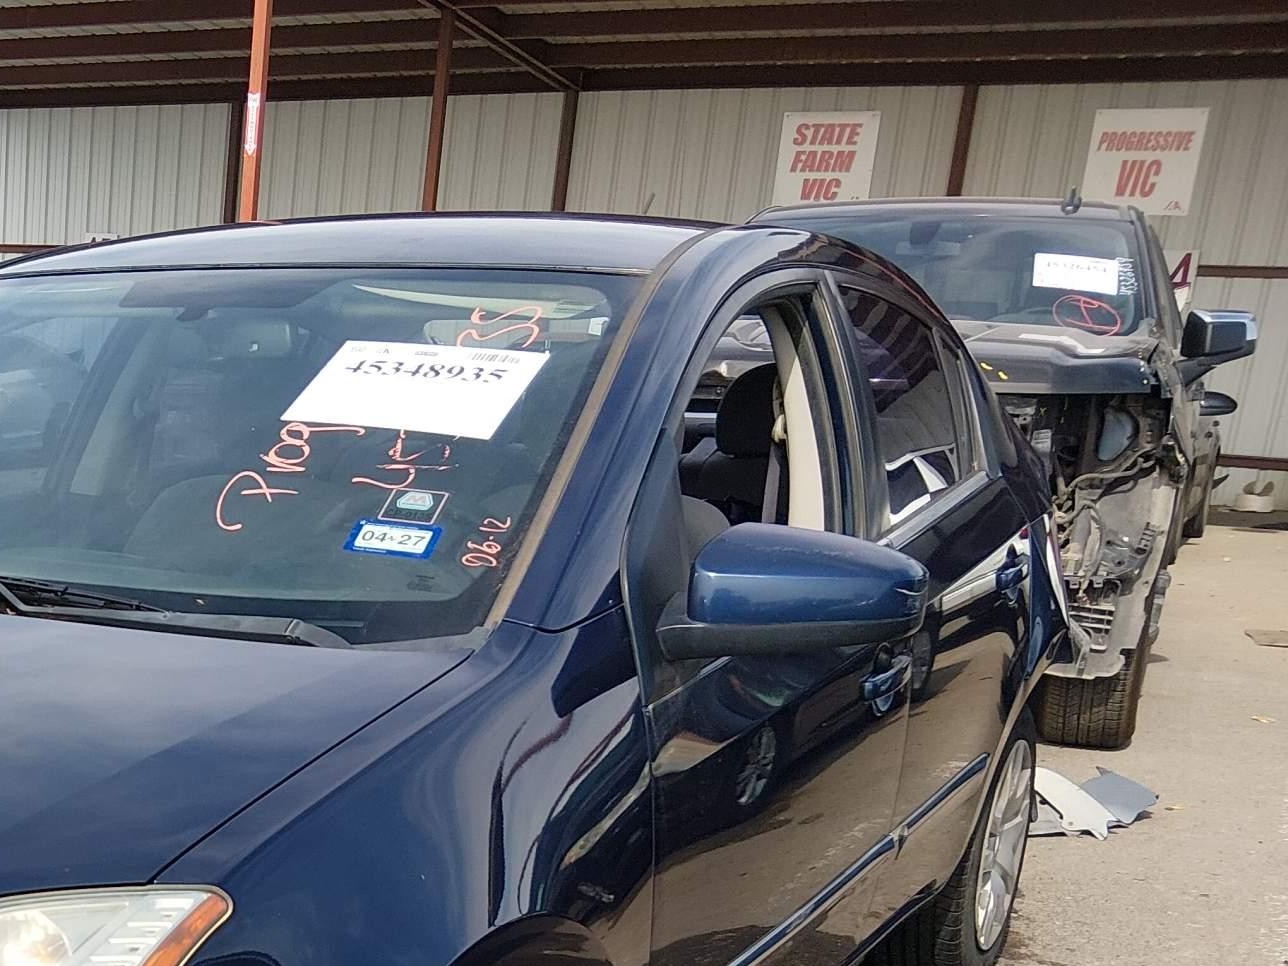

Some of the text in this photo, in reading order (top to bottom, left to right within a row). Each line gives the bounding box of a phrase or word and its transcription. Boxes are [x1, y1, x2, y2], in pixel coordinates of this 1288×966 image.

[793, 123, 864, 146] STATE
[1097, 131, 1196, 152] PROGRESSIVE
[790, 150, 857, 173] FARM
[800, 178, 842, 201] VIC
[1115, 159, 1162, 197] VIC
[345, 360, 509, 384] 45348935
